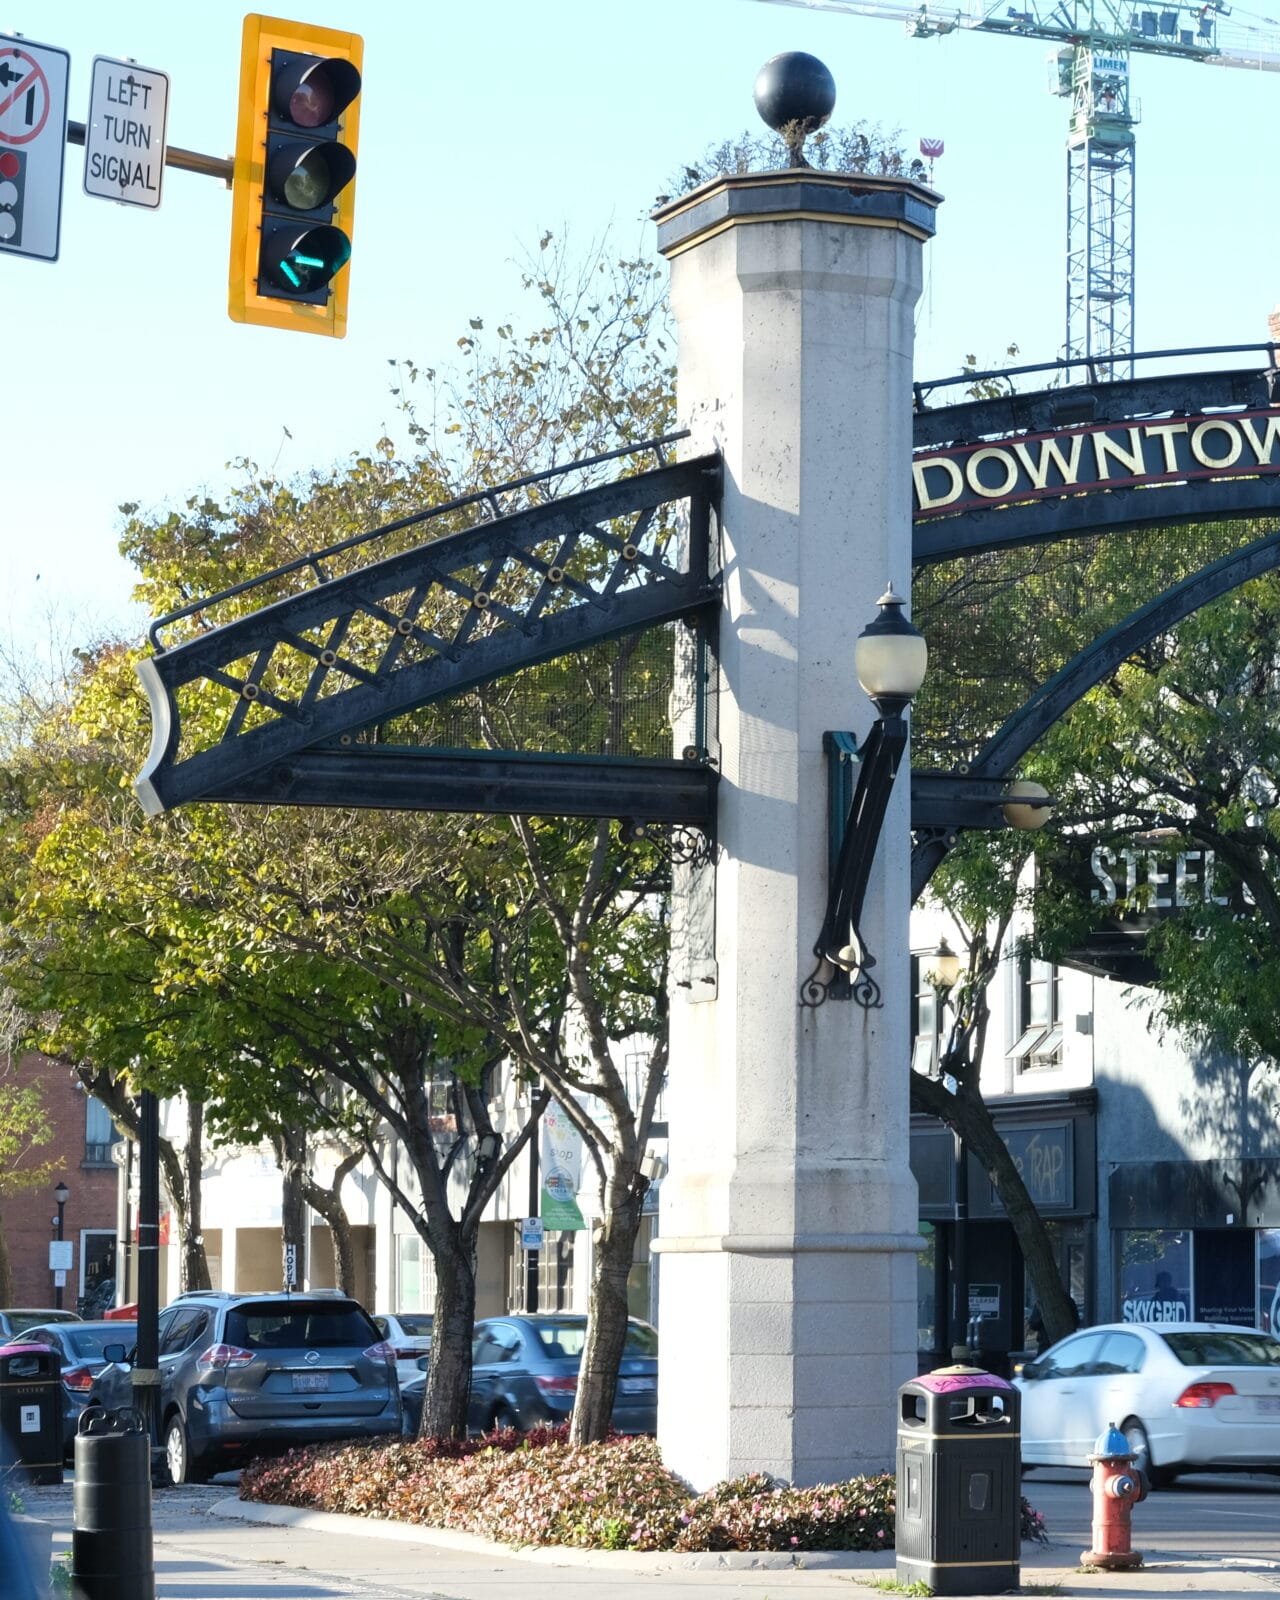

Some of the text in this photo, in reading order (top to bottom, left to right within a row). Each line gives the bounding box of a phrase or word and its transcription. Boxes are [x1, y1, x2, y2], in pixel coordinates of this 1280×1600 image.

[1093, 58, 1127, 72] LIMEN
[107, 76, 152, 110] LEFT
[104, 114, 152, 150] TURN
[90, 152, 157, 191] SIGNAL
[1090, 845, 1229, 909] STEEL
